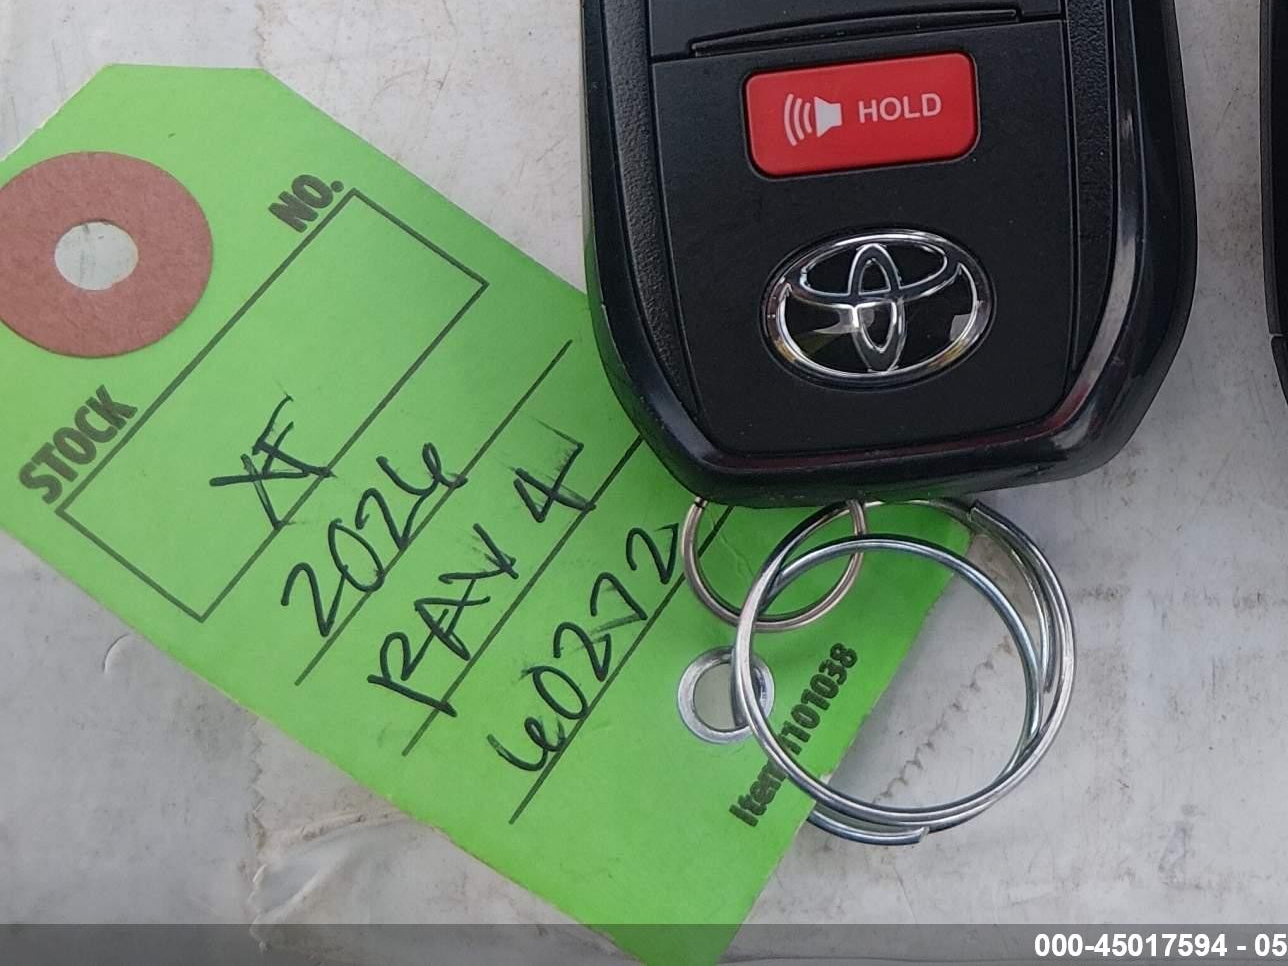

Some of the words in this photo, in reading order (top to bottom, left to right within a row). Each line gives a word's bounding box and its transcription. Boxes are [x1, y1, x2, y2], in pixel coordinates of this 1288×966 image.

[858, 93, 942, 123] HOLD
[18, 384, 138, 505] STOCK
[268, 173, 345, 233] NO.
[281, 442, 468, 638] 2026
[368, 523, 519, 717] RAV
[487, 522, 681, 772] 60272
